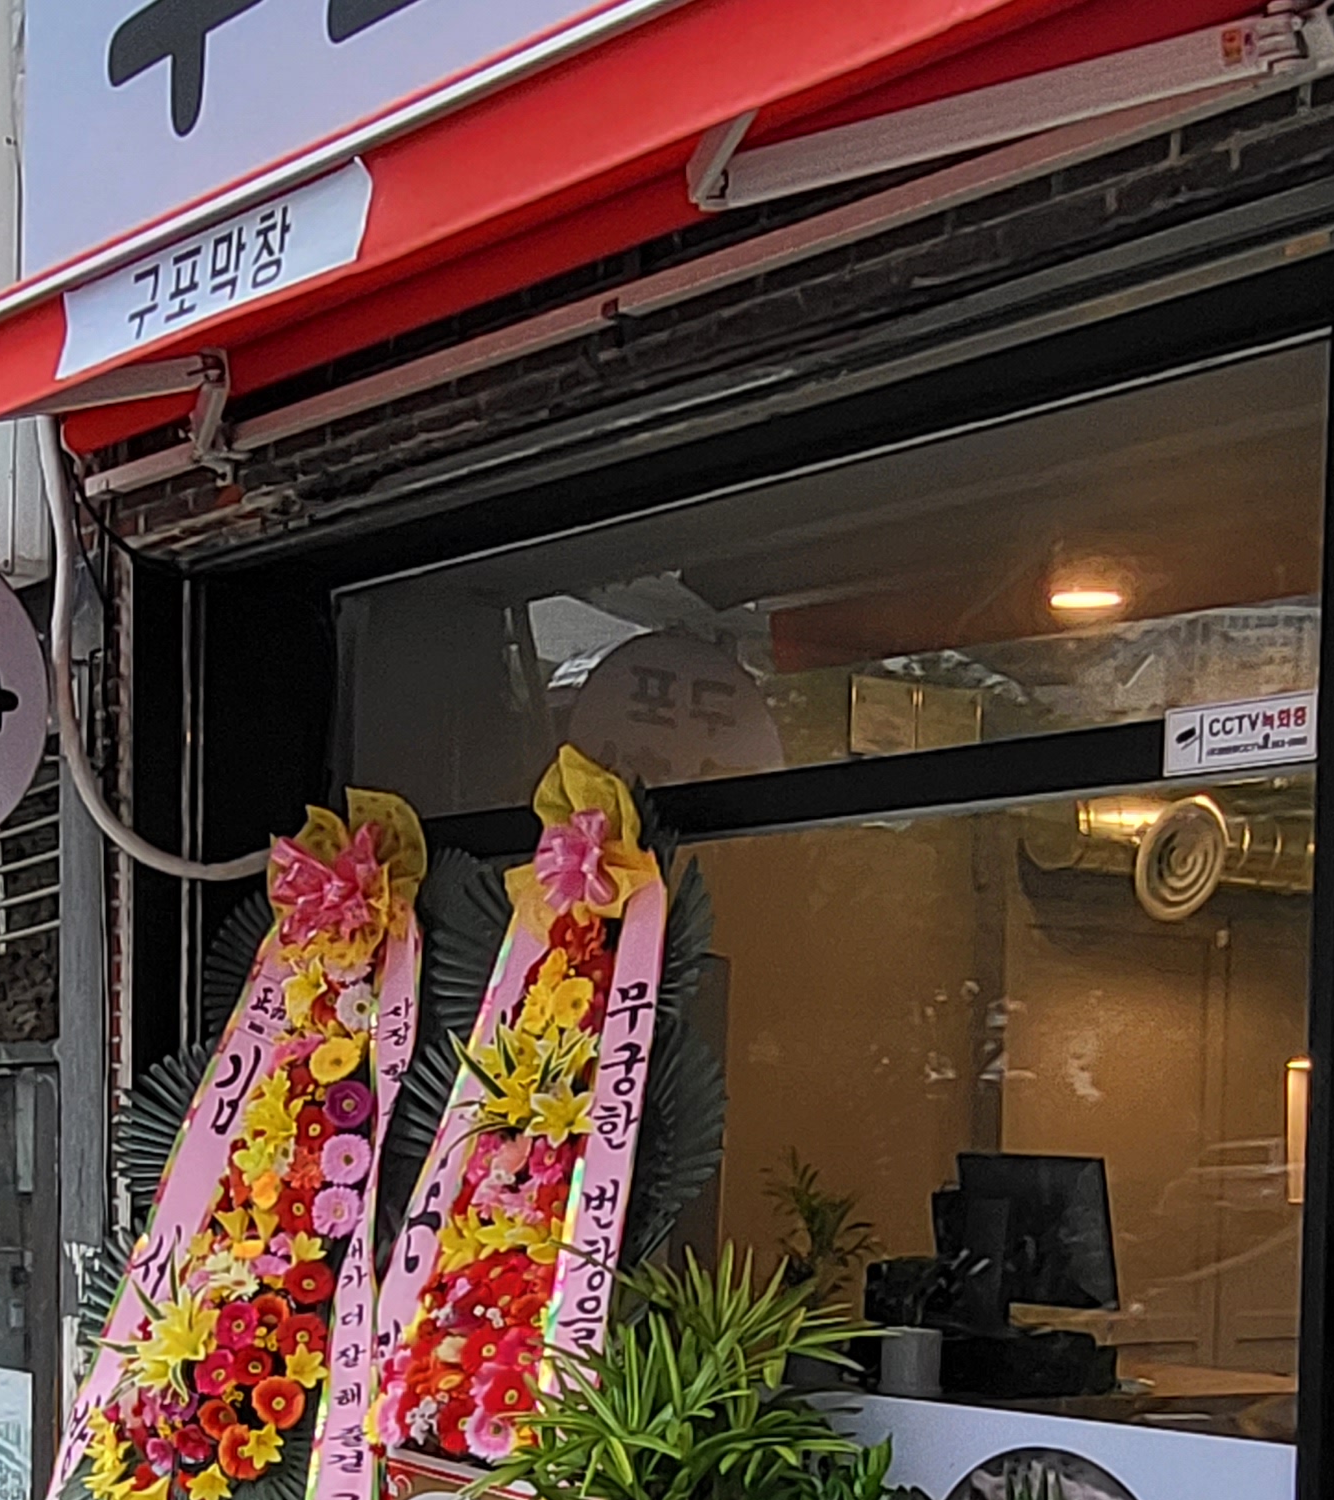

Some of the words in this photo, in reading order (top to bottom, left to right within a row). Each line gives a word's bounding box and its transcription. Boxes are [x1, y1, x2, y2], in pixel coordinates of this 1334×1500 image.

[128, 206, 292, 337] 구포막창
[592, 981, 653, 1150] 무궁한
[558, 1179, 620, 1347] 번창을
